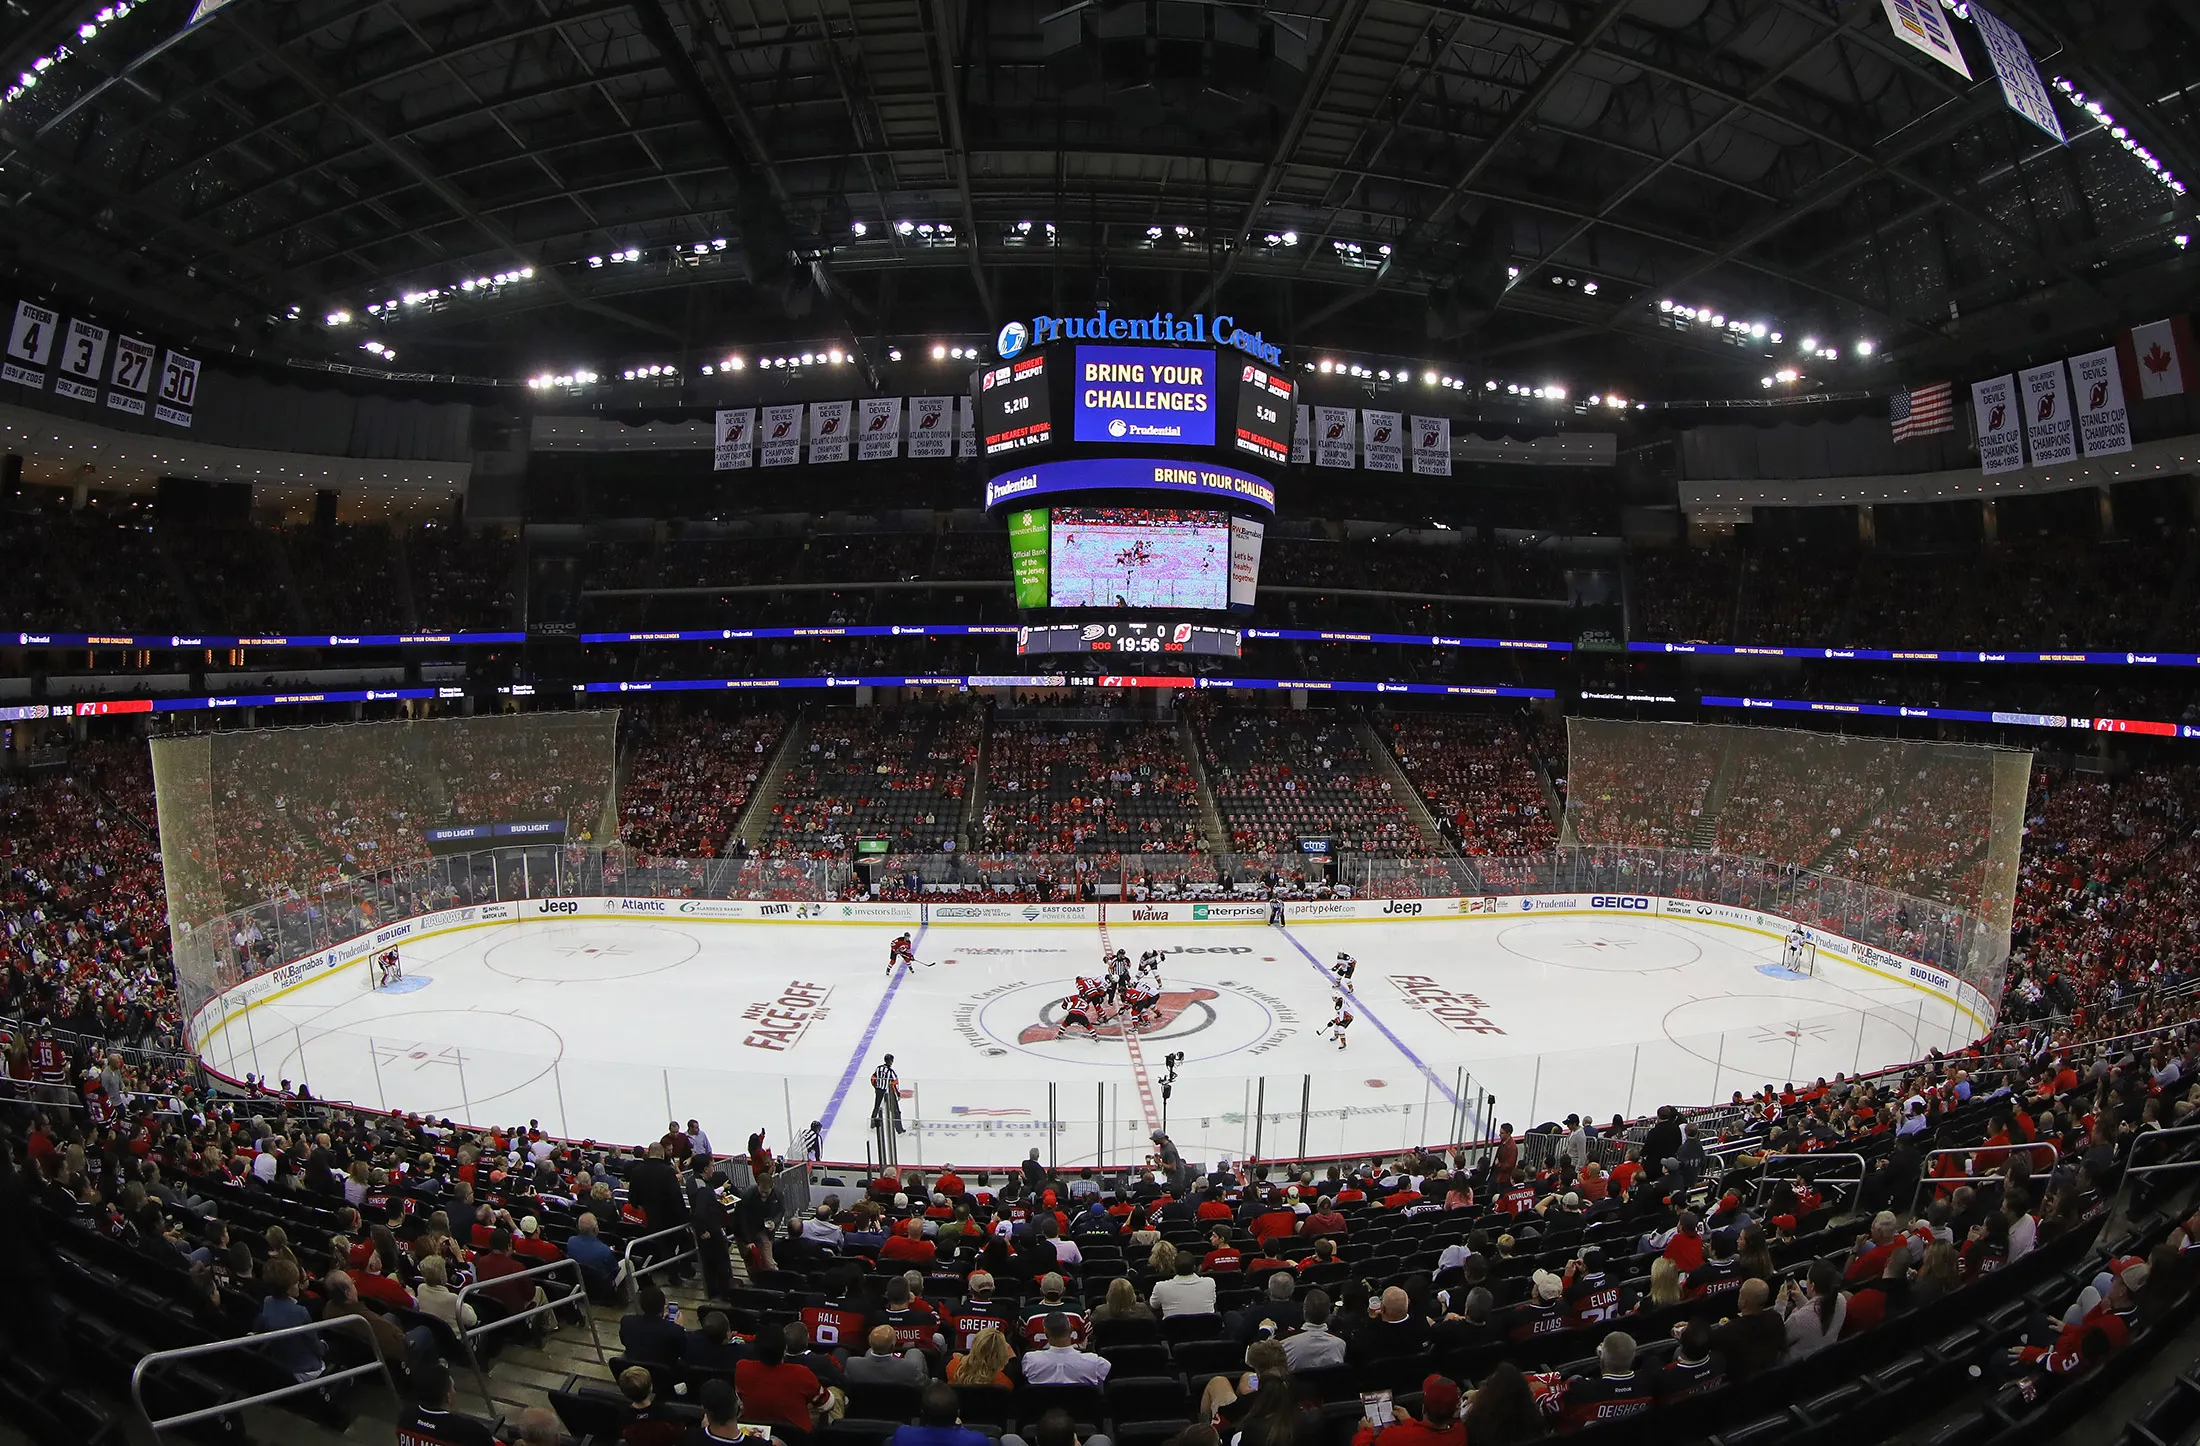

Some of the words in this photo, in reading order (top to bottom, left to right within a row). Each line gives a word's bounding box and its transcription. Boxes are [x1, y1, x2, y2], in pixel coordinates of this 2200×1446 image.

[23, 305, 52, 324] STEVENS
[22, 323, 41, 360] 4
[1032, 310, 1206, 345] Prudential
[1212, 315, 1281, 367] Center
[74, 338, 94, 374] 3
[2079, 362, 2090, 370] NEW
[2091, 357, 2108, 368] JERSEY
[117, 351, 148, 389] 27
[1014, 356, 1044, 372] CURRENT
[26, 371, 43, 385] 2005
[1014, 366, 1043, 382] JACKPOT
[1085, 363, 1144, 384] BRING
[1151, 366, 1203, 386] YOUR
[2083, 367, 2108, 380] DEVILS
[163, 364, 195, 403] 30
[2032, 380, 2056, 393] DEVILS
[80, 385, 96, 399] 2003
[1004, 396, 1029, 414] 5,210
[1084, 389, 1208, 411] CHALLENGES
[1257, 405, 1277, 423] 5,210
[2081, 412, 2110, 427] STANLEY
[2111, 408, 2125, 422] CUP
[986, 434, 1000, 444] VISIT
[1002, 427, 1028, 441] NEAREST
[1129, 425, 1181, 437] Prudential
[2029, 424, 2056, 438] STANLEY
[2058, 420, 2071, 432] CUP
[2085, 423, 2126, 440] CHAMPIONS
[1980, 432, 2005, 447] STANLEY
[2006, 430, 2018, 442] CUP
[2032, 433, 2071, 451] CHAMPIONS
[2088, 438, 2126, 451] 2002-2003
[1983, 443, 2018, 460] CHAMPIONS
[2036, 447, 2071, 461] 1999-2000
[1369, 460, 1398, 470] 2009-2010
[1418, 466, 1446, 474] 2011-2012
[1986, 456, 2018, 469] 1994-1995
[993, 473, 1037, 499] Prudential
[1154, 468, 1196, 485] BRING
[1201, 471, 1232, 491] YOUR
[1010, 524, 1047, 536] investorsBank
[1232, 525, 1261, 539] RWJBarnabas
[1013, 550, 1030, 558] Official
[1235, 551, 1246, 560] Let's
[1247, 553, 1253, 561] be
[1028, 567, 1045, 576] Jersey
[1234, 562, 1252, 573] healthy
[1108, 625, 1117, 636] 0
[1157, 625, 1165, 637] 0
[1092, 642, 1112, 650] SOG
[1117, 637, 1160, 652] 19:56
[1164, 643, 1183, 651] SOG
[1070, 677, 1094, 686] 19:56
[19, 709, 24, 718] 0
[52, 706, 72, 716] 19:56
[102, 704, 107, 713] 0
[2039, 717, 2044, 725] 0
[2070, 719, 2090, 728] 19:56
[2120, 722, 2125, 731] 0
[454, 829, 474, 837] LIGHT
[1303, 841, 1327, 851] ctms
[539, 899, 578, 915] Jeep
[621, 898, 665, 912] Atlantic
[1383, 900, 1422, 916] Jeep
[1535, 898, 1577, 909] Prudential
[1591, 896, 1649, 909] GEICO
[854, 906, 912, 916] investorsBank
[1132, 908, 1168, 921] Wawa
[1196, 906, 1264, 919] enterprise
[1715, 910, 1752, 921] INFINITI
[377, 928, 394, 943] BUD
[394, 924, 411, 939] LIGHT
[338, 939, 372, 962] Prudential
[1163, 945, 1253, 955] Jeep
[1815, 936, 1849, 955] Prudential
[1851, 943, 1902, 970] RWJBarnabas
[1856, 956, 1878, 968] HEALTH
[272, 956, 325, 985] RWJBarnabas
[1910, 966, 1926, 982] BUD
[1926, 972, 1950, 989] LIGHT
[281, 974, 304, 989] HEALTH
[971, 979, 1029, 1001] Center
[1235, 984, 1300, 1024] Prudential
[1389, 974, 1508, 1036] FACE-OFF
[1460, 992, 1491, 1009] NHL
[741, 1001, 771, 1021] NHL
[742, 980, 827, 1052] FACE-OFF
[952, 1002, 992, 1048] Prudential
[1247, 1026, 1299, 1056] Center
[1591, 1288, 1618, 1308] ELIAS
[818, 1312, 841, 1325] HALL
[960, 1317, 1000, 1331] GREENE
[1533, 1317, 1562, 1333] ELIAS
